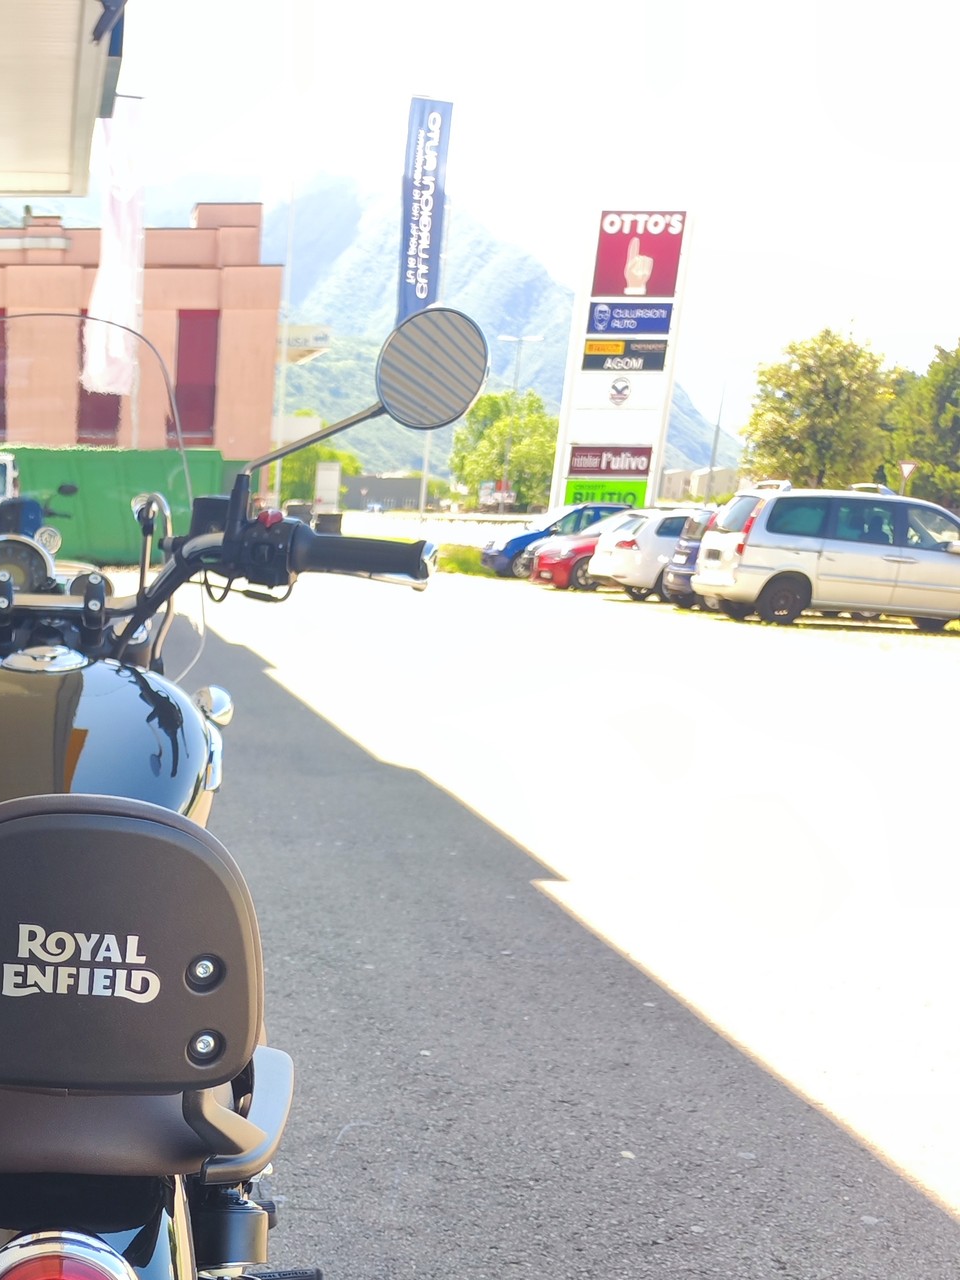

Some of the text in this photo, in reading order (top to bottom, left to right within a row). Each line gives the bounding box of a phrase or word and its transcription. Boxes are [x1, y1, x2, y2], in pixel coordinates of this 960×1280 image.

[602, 213, 683, 235] OTTO'S
[610, 319, 638, 329] AUTO
[600, 451, 648, 470] l'ulivo
[17, 923, 146, 964] ROYAL
[2, 963, 161, 1003] ENFIELD
